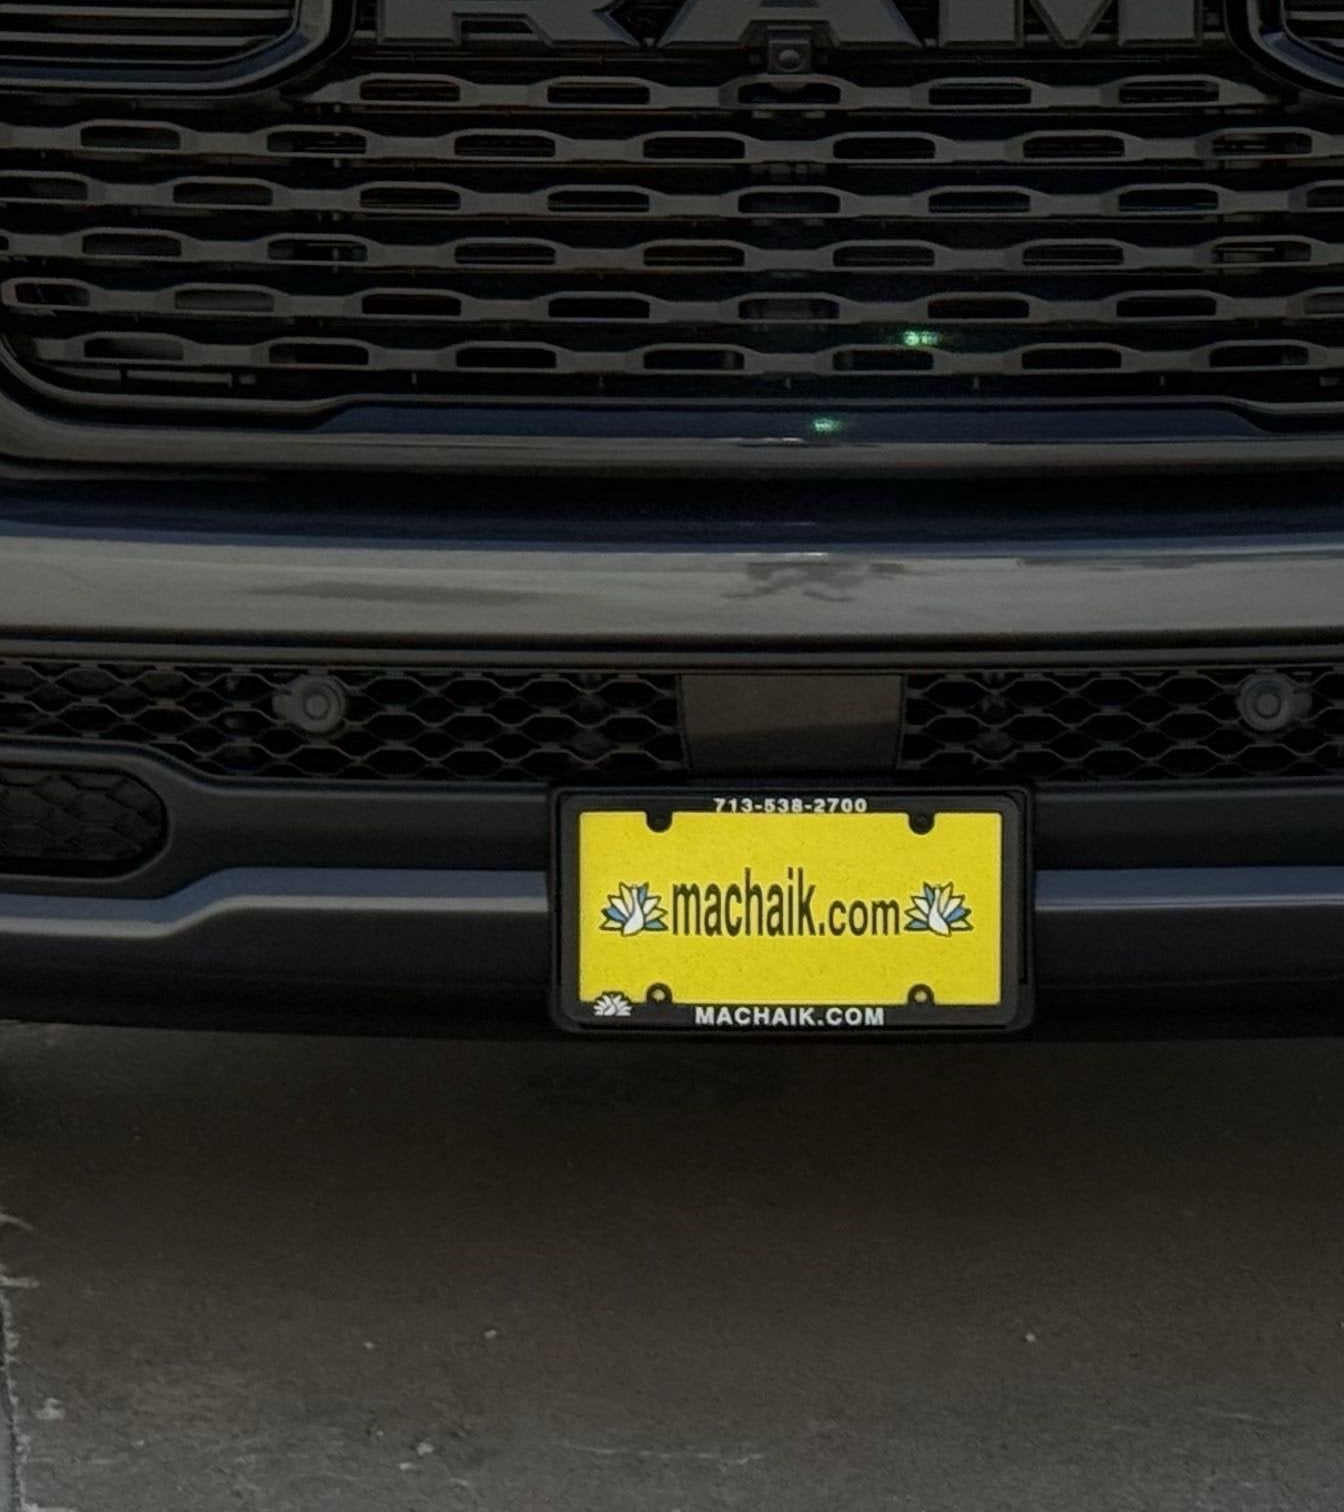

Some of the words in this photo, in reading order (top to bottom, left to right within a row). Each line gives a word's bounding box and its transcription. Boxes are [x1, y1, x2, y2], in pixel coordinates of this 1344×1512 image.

[713, 797, 868, 813] 713-538-2700
[672, 866, 901, 937] machaik.com
[694, 1006, 885, 1026] MACHAIK.COM
